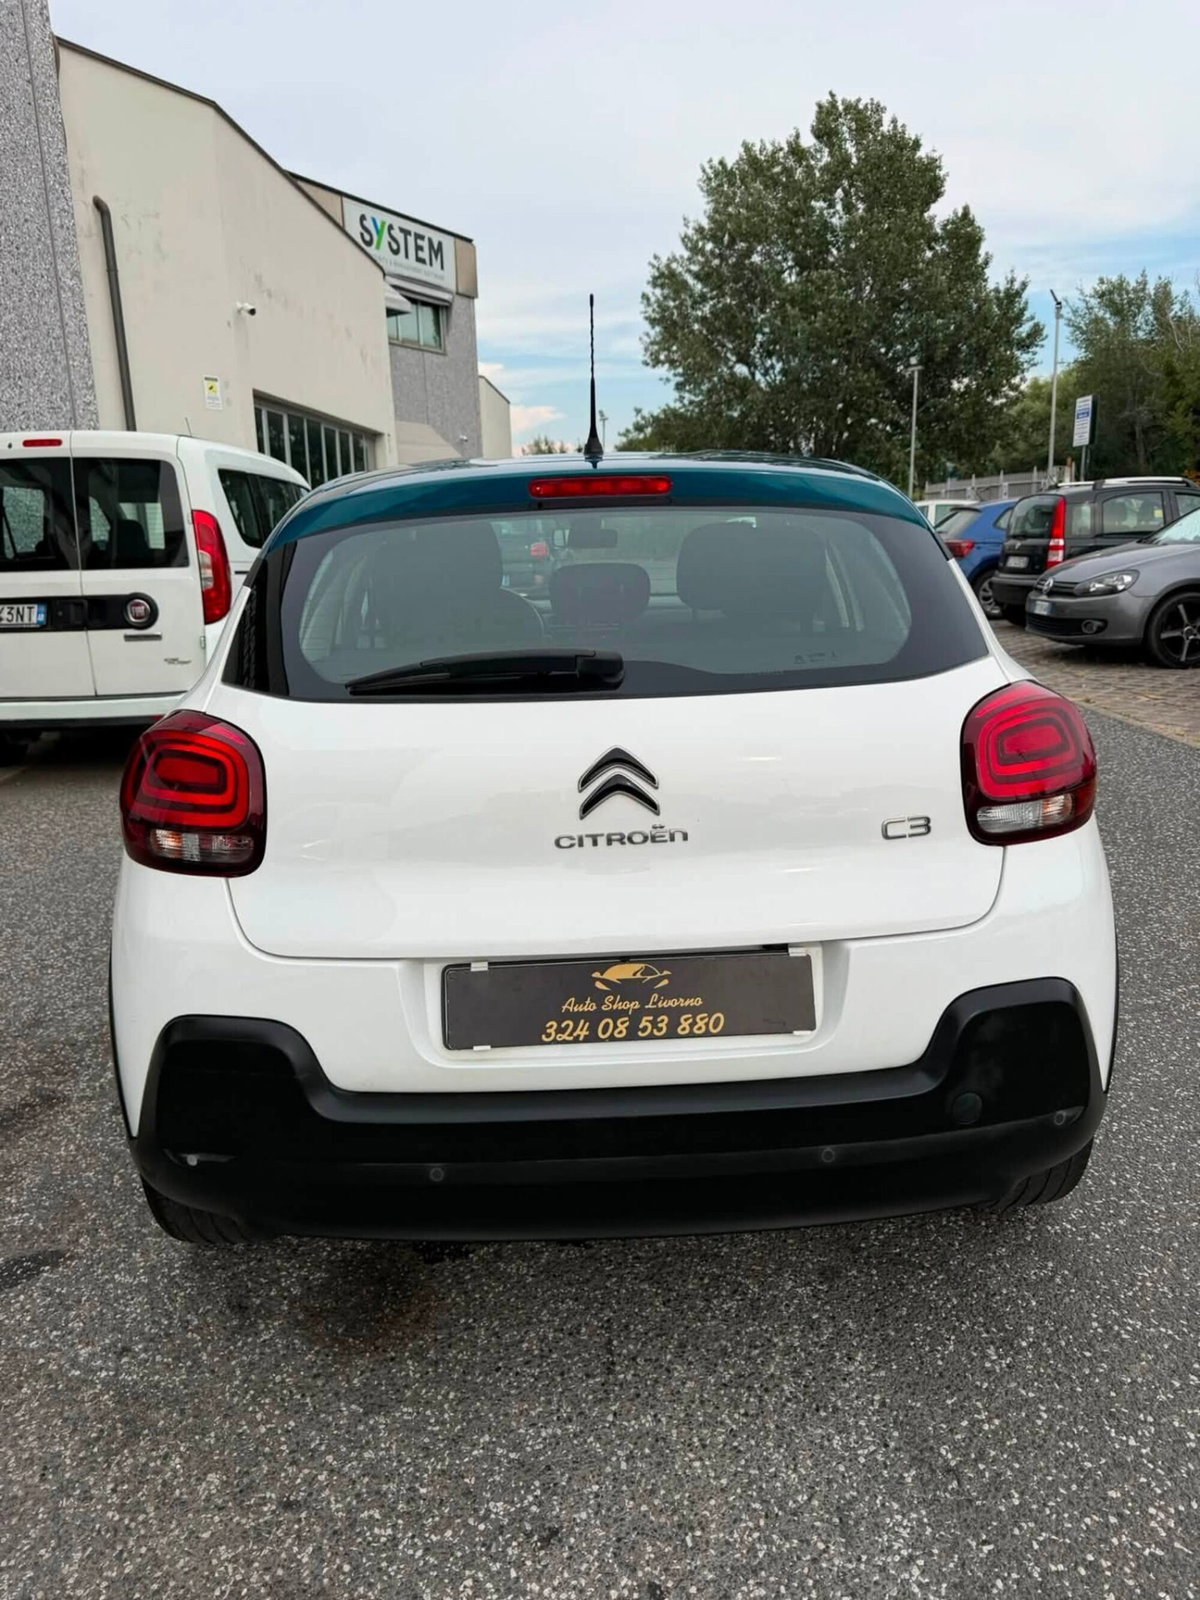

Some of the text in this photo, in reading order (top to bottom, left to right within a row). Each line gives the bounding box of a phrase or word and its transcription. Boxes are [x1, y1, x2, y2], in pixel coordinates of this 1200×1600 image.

[359, 213, 445, 271] SYSTEM
[881, 815, 932, 841] C3
[562, 993, 704, 1014] Auto Shop Livorno
[541, 1012, 726, 1042] 324 08 53 880
